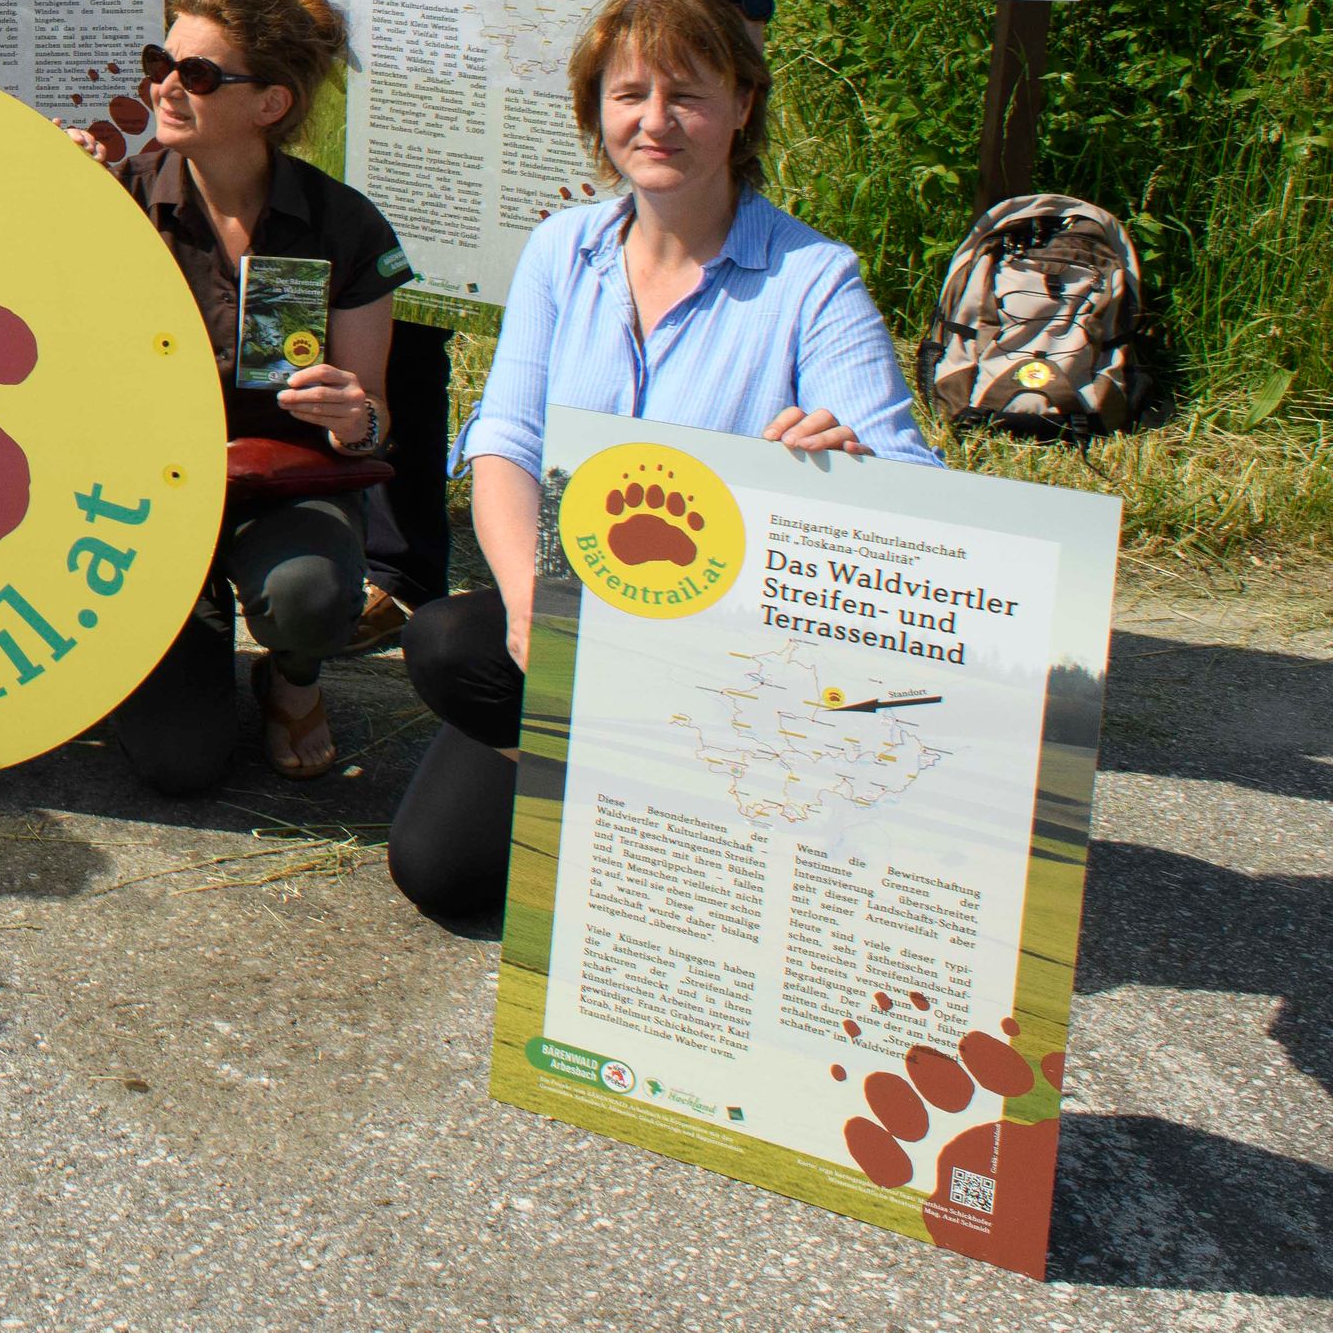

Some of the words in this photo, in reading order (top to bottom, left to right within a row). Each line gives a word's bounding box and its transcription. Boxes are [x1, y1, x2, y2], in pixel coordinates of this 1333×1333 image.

[768, 532, 790, 542] mit
[770, 515, 848, 538] Einzigartige
[852, 529, 966, 559] Kulturlandschaft
[575, 532, 728, 605] Bärentrail.at
[765, 550, 816, 577] Das
[827, 561, 1018, 615] Waldviertler
[763, 577, 888, 618] Streifen-
[899, 609, 955, 633] und
[761, 604, 964, 664] Terrassenland
[888, 689, 926, 698] Standort
[597, 793, 625, 807] Diese
[647, 806, 727, 833] Besonderheiten
[750, 832, 768, 843] der
[597, 805, 659, 828] Waldviertler
[667, 823, 753, 852] Kulturlandschaft
[593, 843, 612, 853] und
[623, 849, 705, 877] Baumgrüppchen
[733, 878, 763, 892] fallen
[594, 831, 613, 841] und
[619, 835, 666, 855] Terrassen
[671, 851, 689, 860] mit
[695, 855, 722, 869] ihren
[728, 864, 764, 880] Büheln
[595, 818, 610, 828] die
[613, 824, 637, 835] sanft
[639, 831, 721, 857] geschwungenen
[723, 850, 765, 868] Streifen
[590, 877, 602, 886] da
[665, 897, 693, 911] Diese
[708, 910, 760, 930] einmalige
[592, 855, 622, 868] vielen
[627, 862, 678, 882] Menschen
[682, 878, 730, 896] vielleicht
[735, 893, 762, 905] nicht
[625, 876, 647, 886] weil
[649, 882, 664, 891] sie
[666, 886, 691, 898] eben
[694, 893, 728, 908] immer
[730, 904, 761, 917] schon
[588, 902, 645, 923] weitgehend
[589, 888, 643, 910] Landschaft
[648, 906, 680, 920] wurde
[685, 915, 715, 929] daher
[721, 924, 758, 943] bislang
[583, 947, 636, 969] Strukturen
[649, 966, 666, 977] der
[584, 936, 600, 946] die
[612, 944, 675, 968] ästhetischen
[688, 965, 720, 981] Linien
[734, 980, 755, 991] und
[586, 923, 611, 937] Viele
[618, 933, 660, 951] Künstler
[668, 946, 715, 967] hingegen
[723, 962, 755, 978] haben
[582, 970, 654, 998] künstlerischen
[659, 994, 704, 1013] Arbeiten
[708, 1008, 750, 1025] intensiv
[624, 973, 668, 990] entdeckt
[677, 988, 696, 998] und
[705, 994, 715, 1004] in
[724, 1000, 751, 1015] ihren
[614, 1004, 651, 1022] Helmut
[719, 1035, 748, 1051] Franz
[638, 999, 665, 1014] Franz
[727, 1025, 749, 1039] Karl
[643, 1025, 672, 1040] Linde
[674, 1034, 707, 1050] Waber
[542, 1044, 598, 1069] BÄRENWALD
[550, 1058, 596, 1081] Arbesbach
